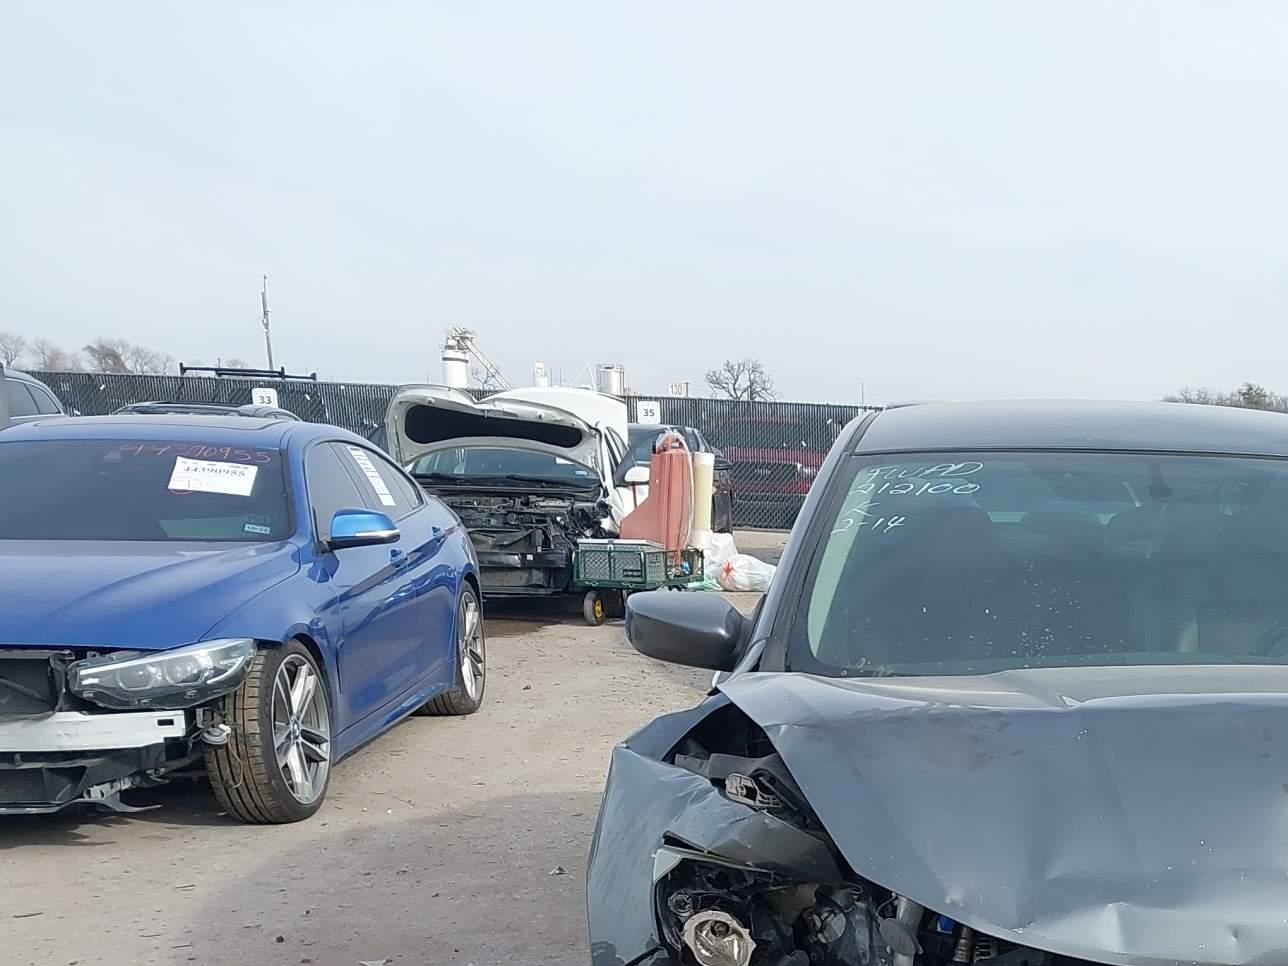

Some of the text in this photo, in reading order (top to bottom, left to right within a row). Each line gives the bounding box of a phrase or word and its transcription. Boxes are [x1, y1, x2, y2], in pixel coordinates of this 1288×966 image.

[259, 395, 272, 405] 33
[643, 408, 655, 417] 35
[849, 482, 981, 496] 212100
